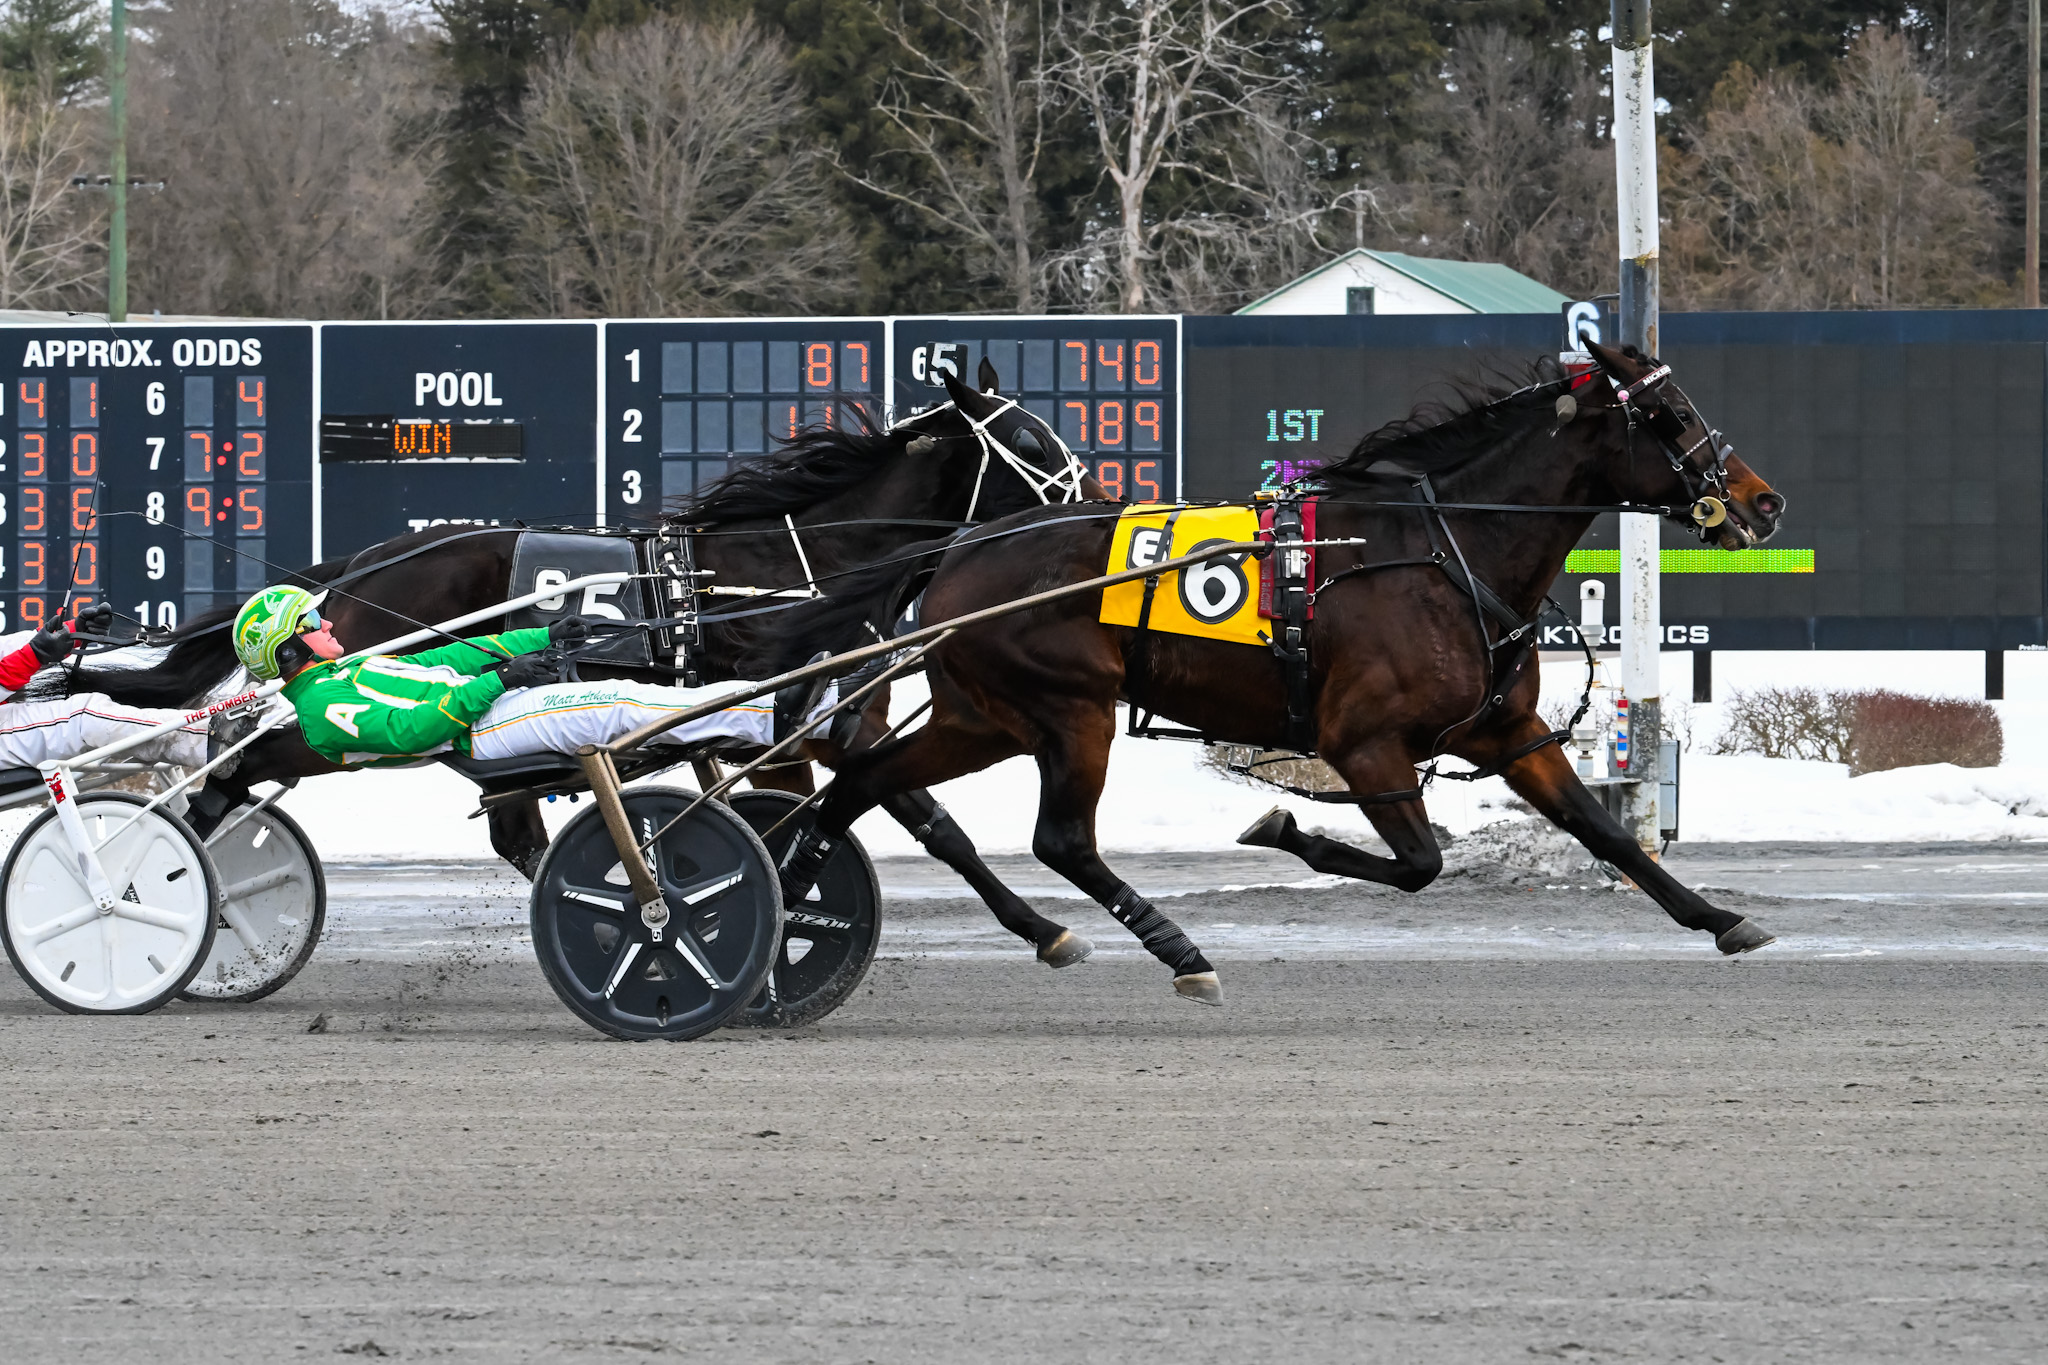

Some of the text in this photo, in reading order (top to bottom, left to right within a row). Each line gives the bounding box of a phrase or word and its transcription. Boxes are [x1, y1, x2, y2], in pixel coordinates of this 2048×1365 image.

[1568, 302, 1600, 352] 6
[22, 338, 262, 368] APPROX. ODDS
[624, 349, 640, 382] 1
[807, 343, 868, 387] 87
[929, 343, 958, 388] 5
[1065, 341, 1160, 385] 740
[146, 381, 166, 416] 6
[239, 381, 263, 418] 4
[415, 372, 503, 407] POOL
[395, 424, 451, 454] WIN
[622, 408, 643, 442] 2
[1065, 401, 1160, 445] 789
[1267, 409, 1325, 441] 1ST
[146, 437, 165, 470] 7
[622, 469, 642, 504] 3
[146, 491, 165, 526] 8
[145, 546, 166, 580] 9
[1184, 545, 1242, 617] 6
[134, 600, 178, 633] 10
[184, 690, 258, 724] THE BOMBER
[543, 694, 575, 707] Matt
[324, 703, 371, 739] A
